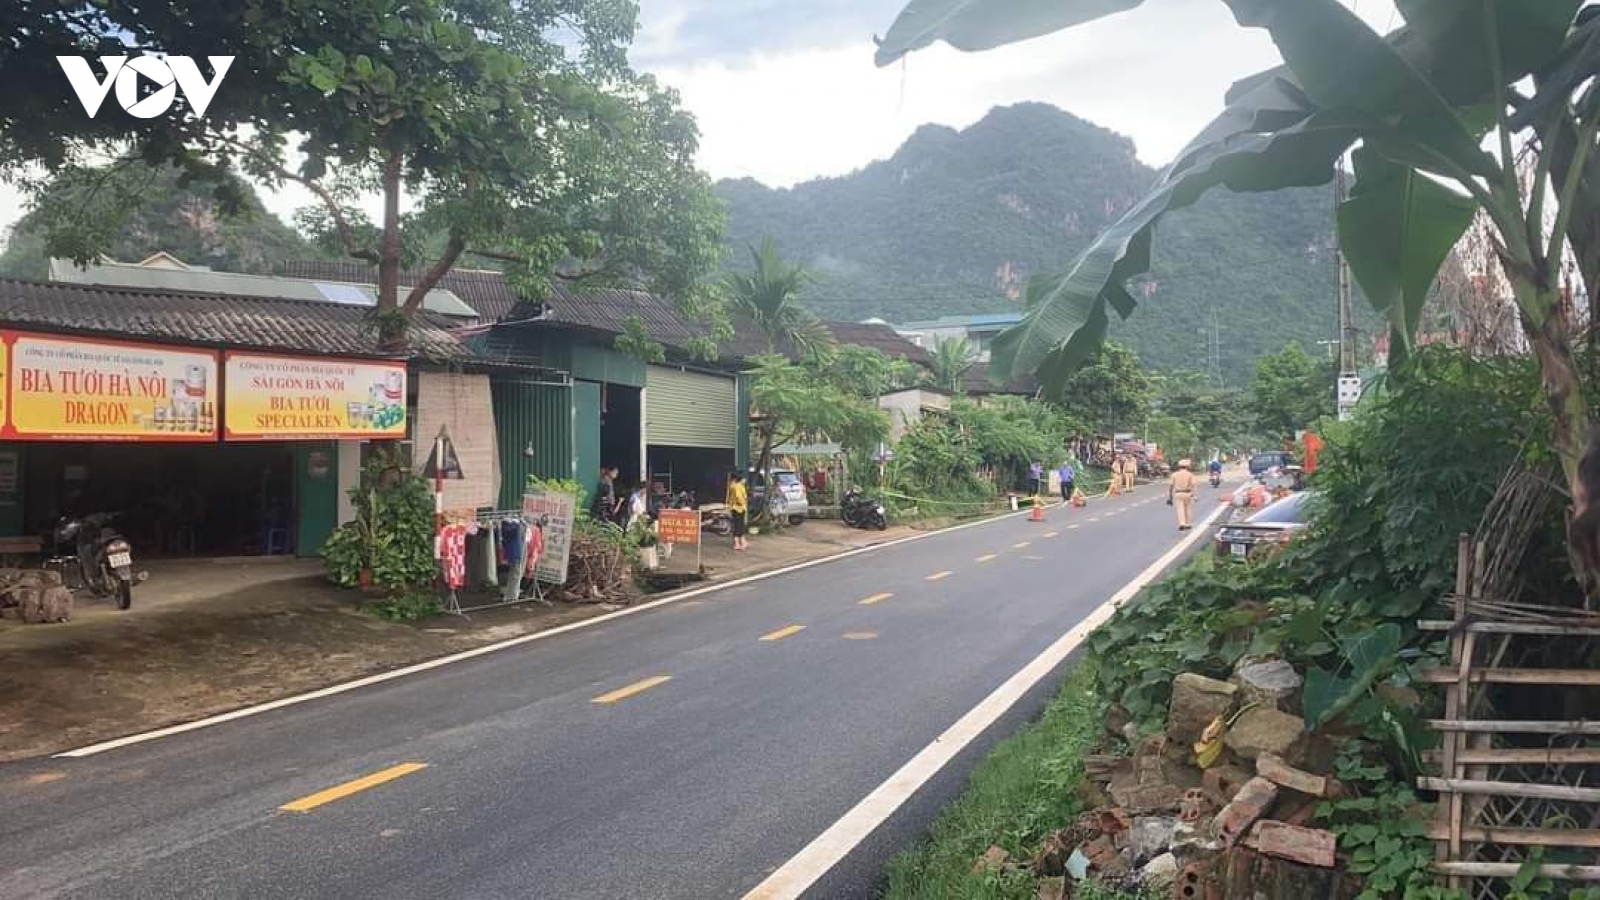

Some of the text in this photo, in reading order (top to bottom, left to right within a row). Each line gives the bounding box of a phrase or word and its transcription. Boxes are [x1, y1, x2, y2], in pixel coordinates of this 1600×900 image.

[21, 368, 53, 392] BIA
[59, 367, 103, 395] TƯƠI
[110, 367, 131, 396] HÀ
[137, 370, 166, 401] NỘI
[253, 373, 344, 391] SÀI GÒN HÀ NỘI
[270, 395, 330, 411] BIA TƯƠI
[65, 401, 129, 425] DRAGON
[256, 414, 342, 428] SPECIALKEN
